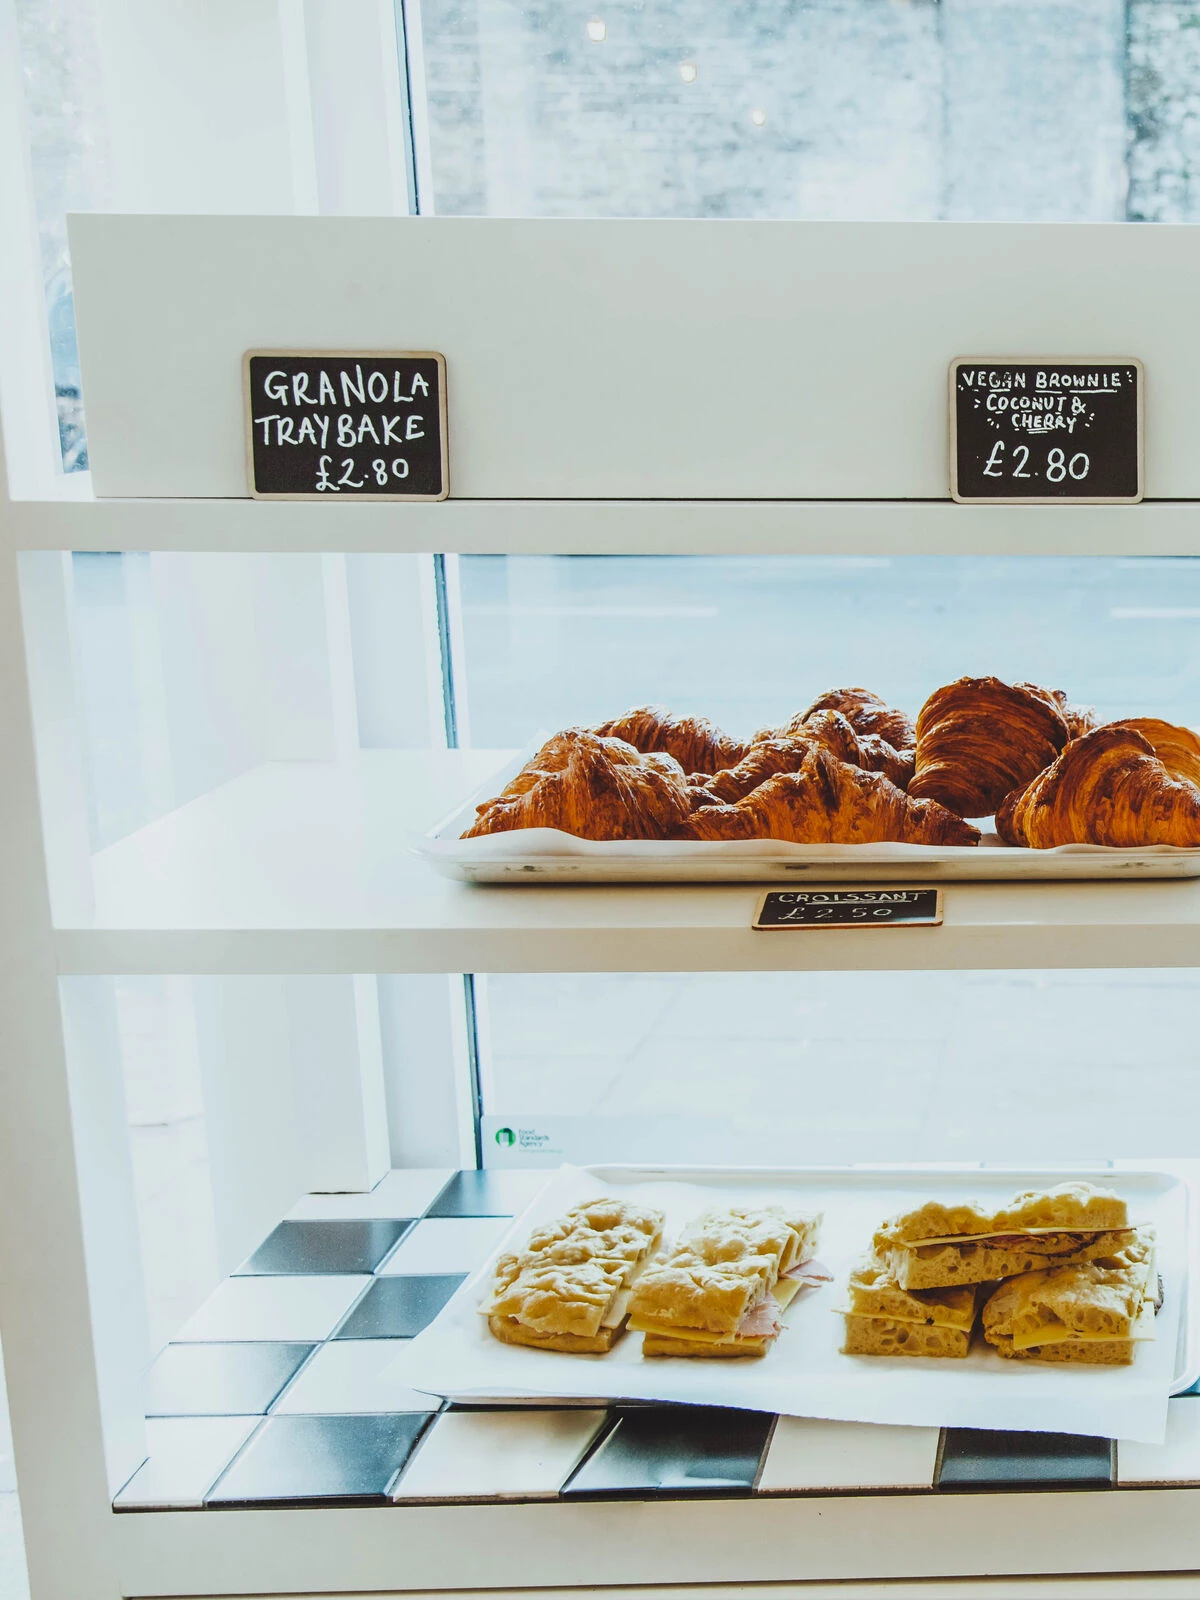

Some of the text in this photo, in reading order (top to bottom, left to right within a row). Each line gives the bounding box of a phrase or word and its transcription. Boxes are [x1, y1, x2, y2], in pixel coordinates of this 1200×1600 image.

[263, 364, 430, 407] GRANOLA
[962, 371, 1122, 389] VEGAN BROWNIE
[986, 393, 1086, 414] COCONUT &
[254, 413, 426, 449] TRAYBAKE
[1011, 413, 1078, 434] CHERRY
[983, 440, 1090, 482] £2.80
[315, 455, 410, 491] £2.80
[778, 892, 927, 904] CROISSANT
[778, 906, 893, 920] £2.50
